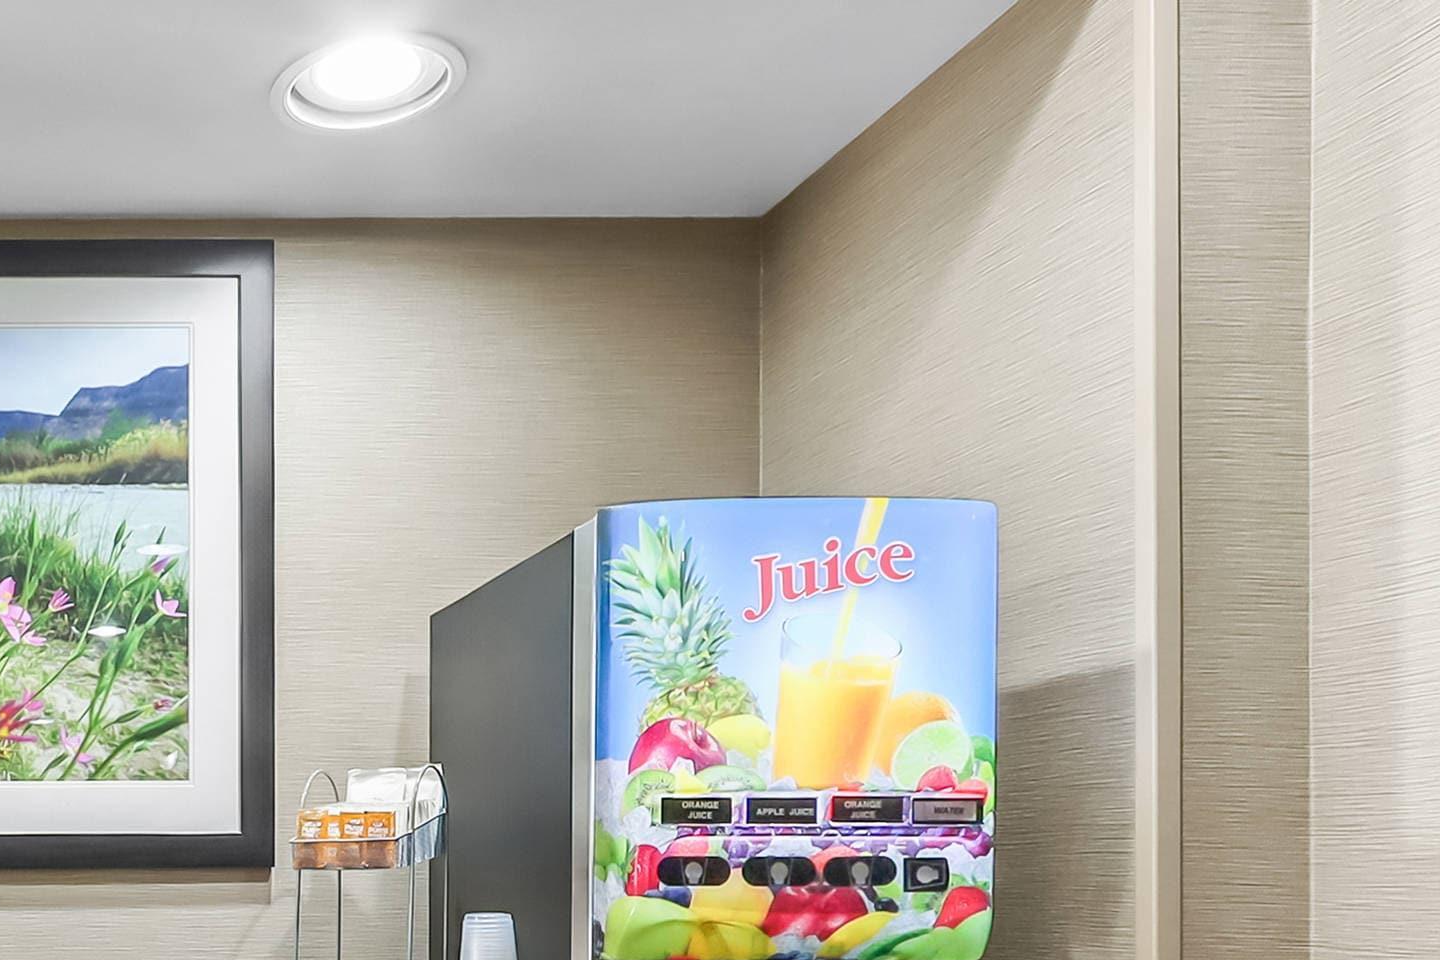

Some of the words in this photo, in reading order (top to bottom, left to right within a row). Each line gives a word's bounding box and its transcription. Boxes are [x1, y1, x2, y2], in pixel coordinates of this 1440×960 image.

[743, 538, 914, 622] Juice
[681, 800, 720, 809] ORANGE
[844, 800, 882, 809] ORANGE
[687, 811, 713, 820] JUICE
[756, 807, 784, 816] APPLE
[789, 808, 815, 816] JUICE
[850, 810, 877, 819] JUICE
